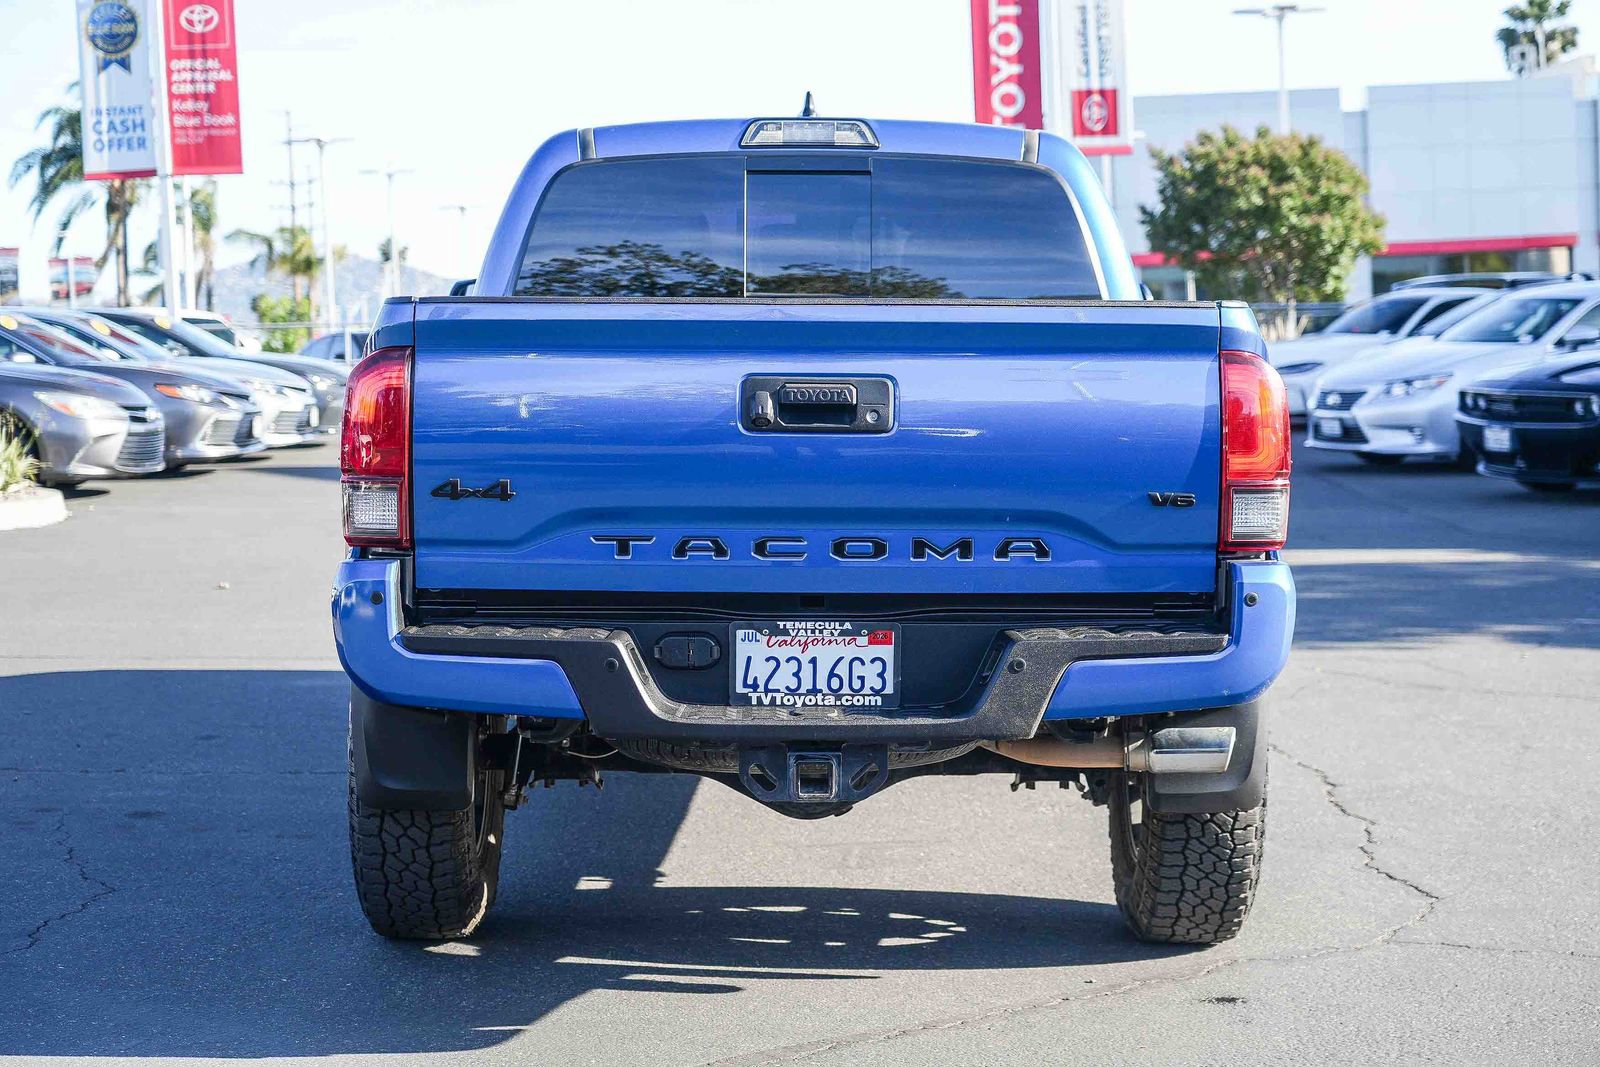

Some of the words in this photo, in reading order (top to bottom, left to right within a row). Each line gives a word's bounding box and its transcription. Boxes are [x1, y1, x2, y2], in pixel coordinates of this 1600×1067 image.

[92, 119, 146, 135] CASH
[93, 136, 147, 152] OFFER
[785, 388, 852, 403] TOYOTA
[1147, 491, 1196, 508] V6
[589, 535, 1052, 562] TACOMA
[777, 621, 853, 630] TEMECULA
[788, 629, 842, 637] VALLEY
[740, 631, 761, 643] JUL
[766, 634, 869, 654] California
[872, 632, 889, 640] 2026
[742, 655, 888, 694] 42316G3
[748, 692, 882, 708] TVToyota.com
